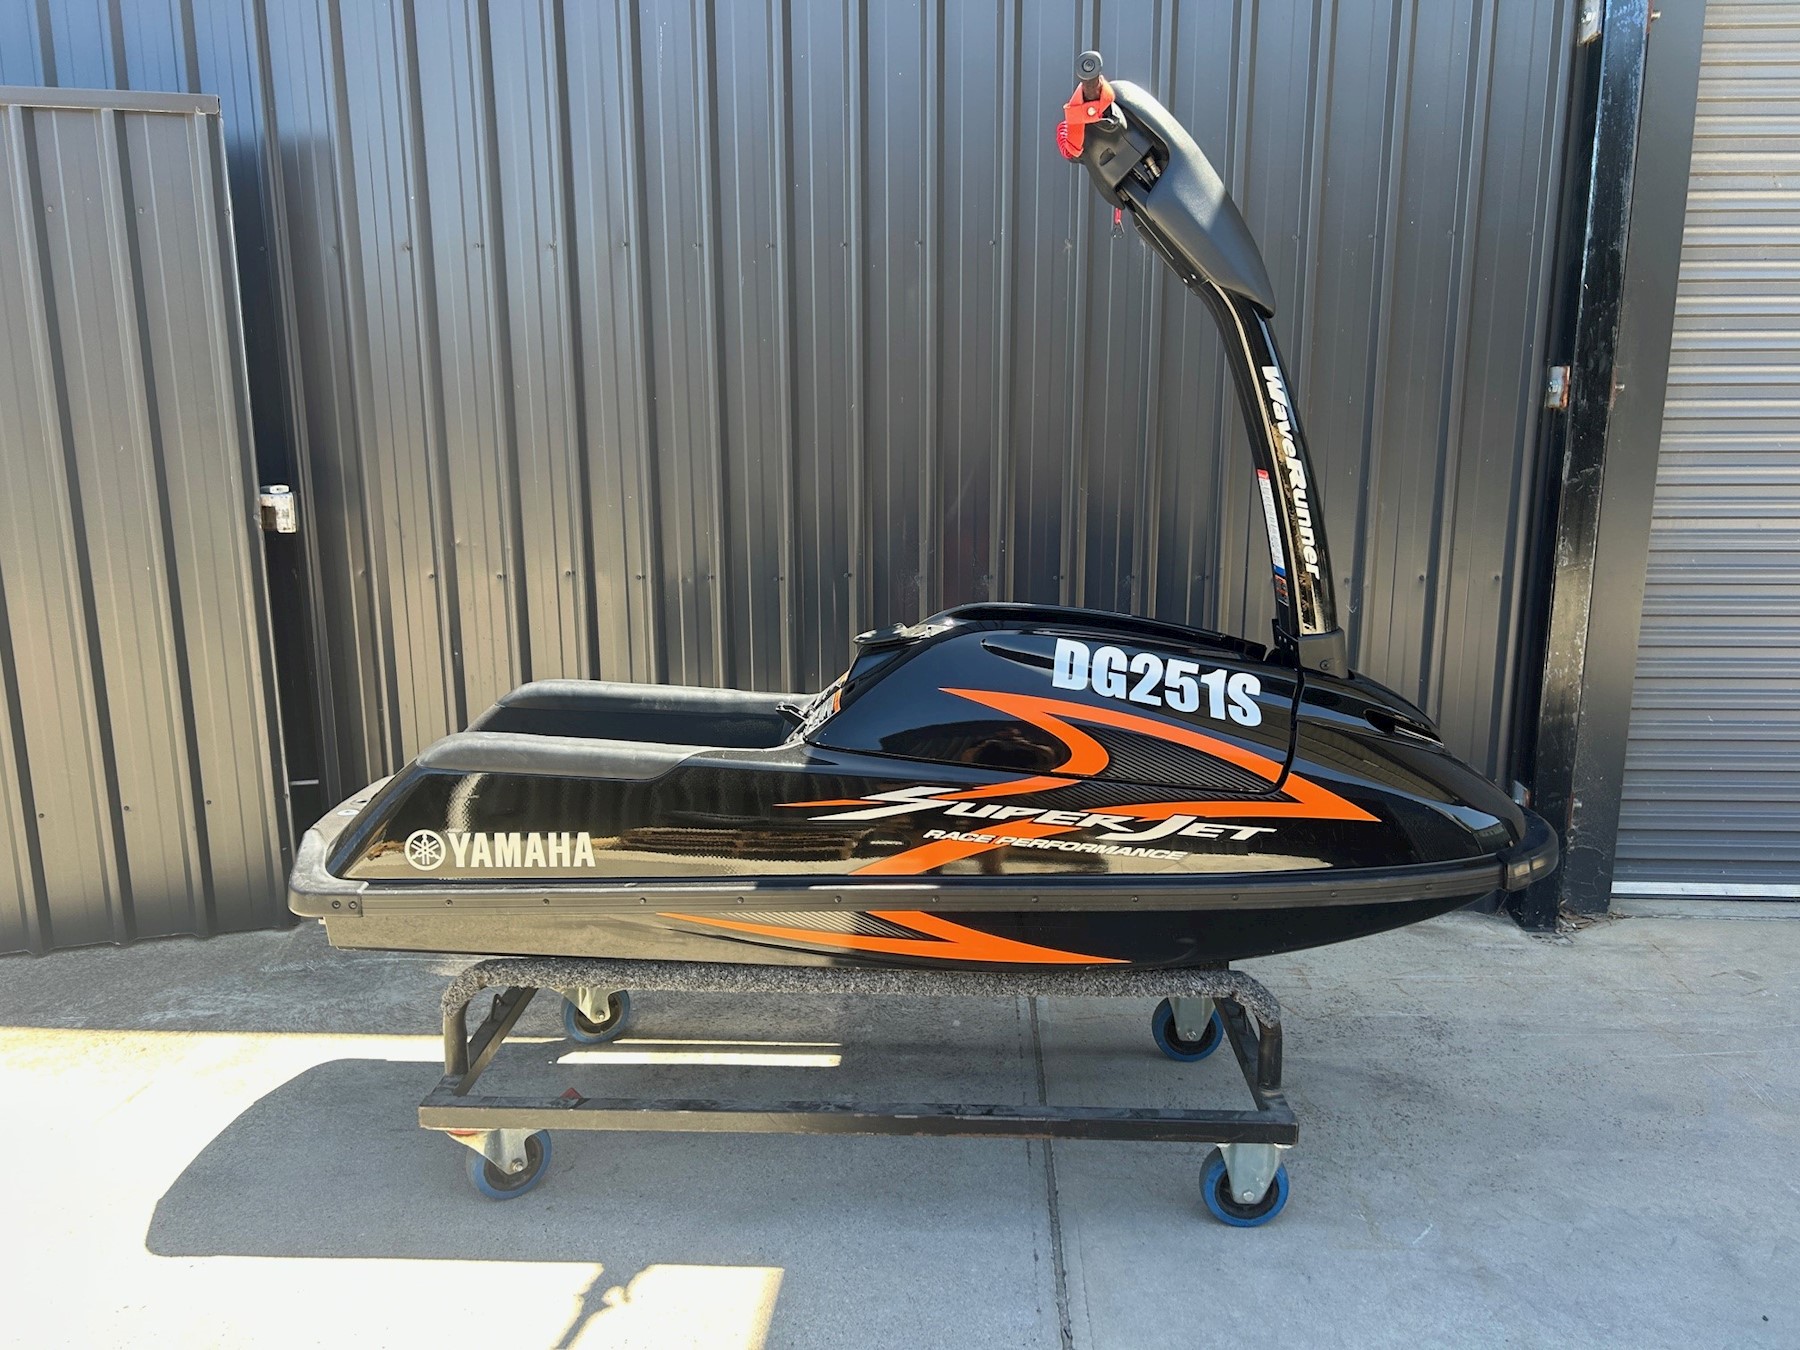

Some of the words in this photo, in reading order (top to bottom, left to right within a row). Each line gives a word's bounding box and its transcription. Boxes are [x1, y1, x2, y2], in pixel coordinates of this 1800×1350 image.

[1262, 366, 1320, 580] WaveRunner
[1052, 638, 1262, 727] DG251S
[447, 831, 596, 868] YAMAHA
[923, 829, 994, 844] RACE
[994, 836, 1188, 860] PERFORMANCE
